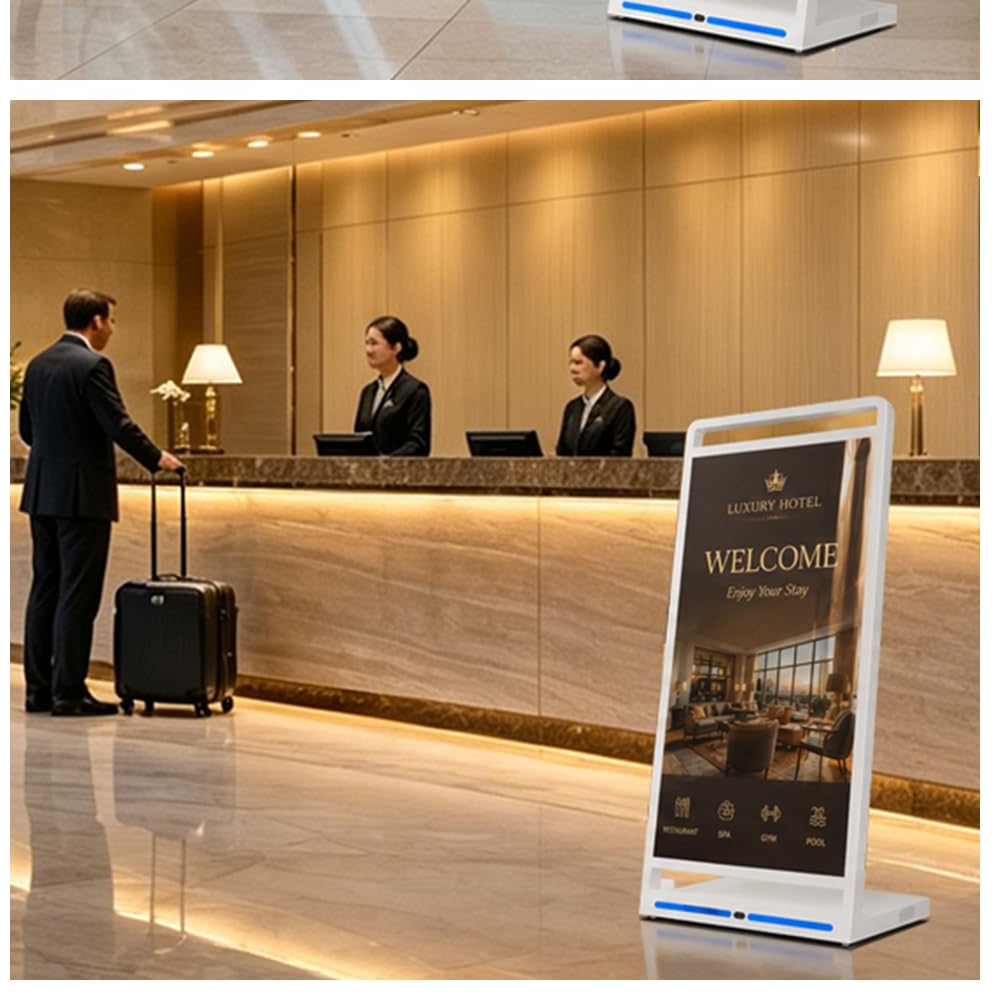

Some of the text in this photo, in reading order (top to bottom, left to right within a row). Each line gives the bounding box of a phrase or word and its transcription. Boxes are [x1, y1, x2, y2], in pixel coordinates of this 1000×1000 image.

[727, 495, 822, 515] LUXURY HOTEL
[704, 542, 840, 575] WELCOME
[726, 583, 809, 602] Enjoy Your Stay
[717, 829, 732, 839] SPA
[806, 836, 826, 848] POOL
